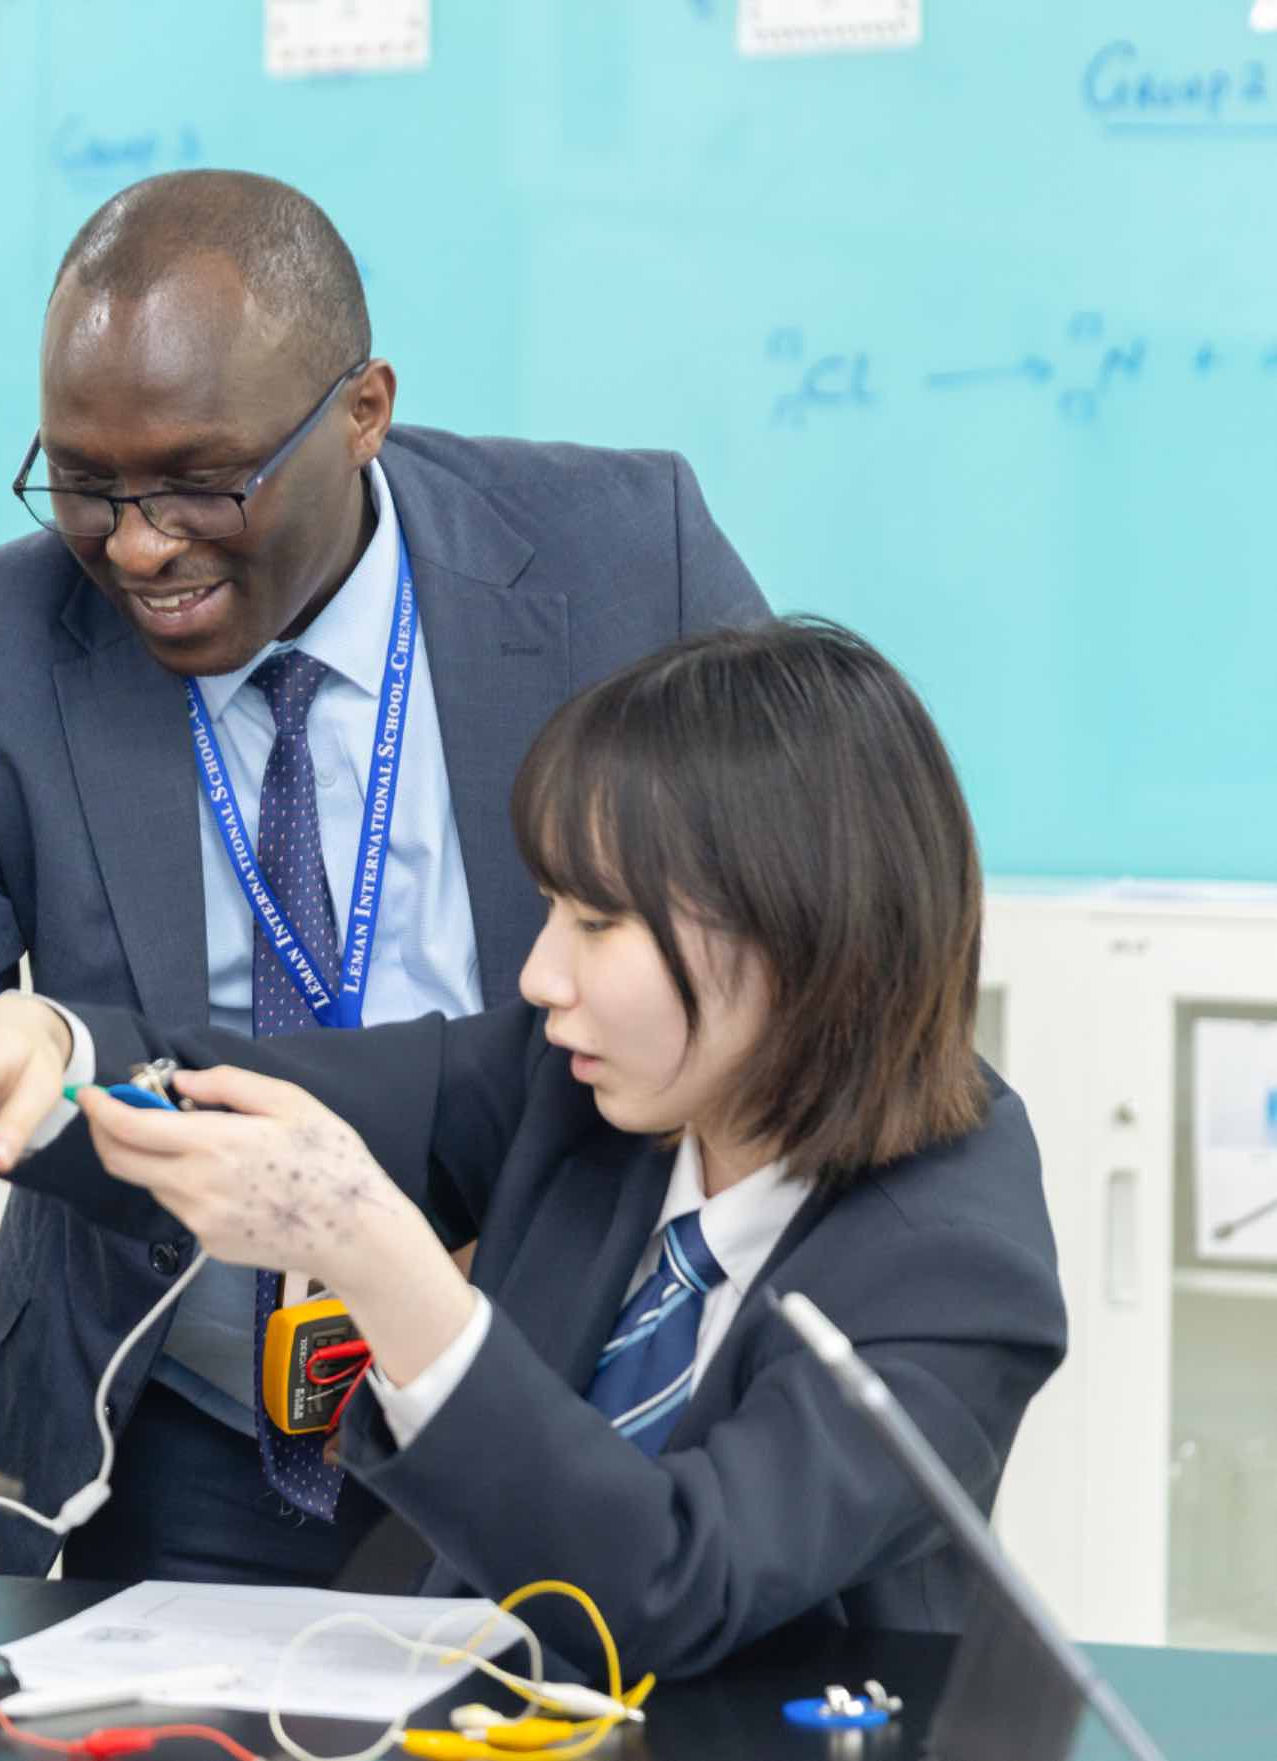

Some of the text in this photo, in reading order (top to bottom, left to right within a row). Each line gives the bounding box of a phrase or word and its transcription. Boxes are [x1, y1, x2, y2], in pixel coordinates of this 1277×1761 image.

[221, 802, 294, 948] INTERNATIONAL
[354, 763, 393, 918] INTERNATIONAL
[288, 948, 331, 1009] LÉMAN
[343, 923, 369, 994] LÉMAN
